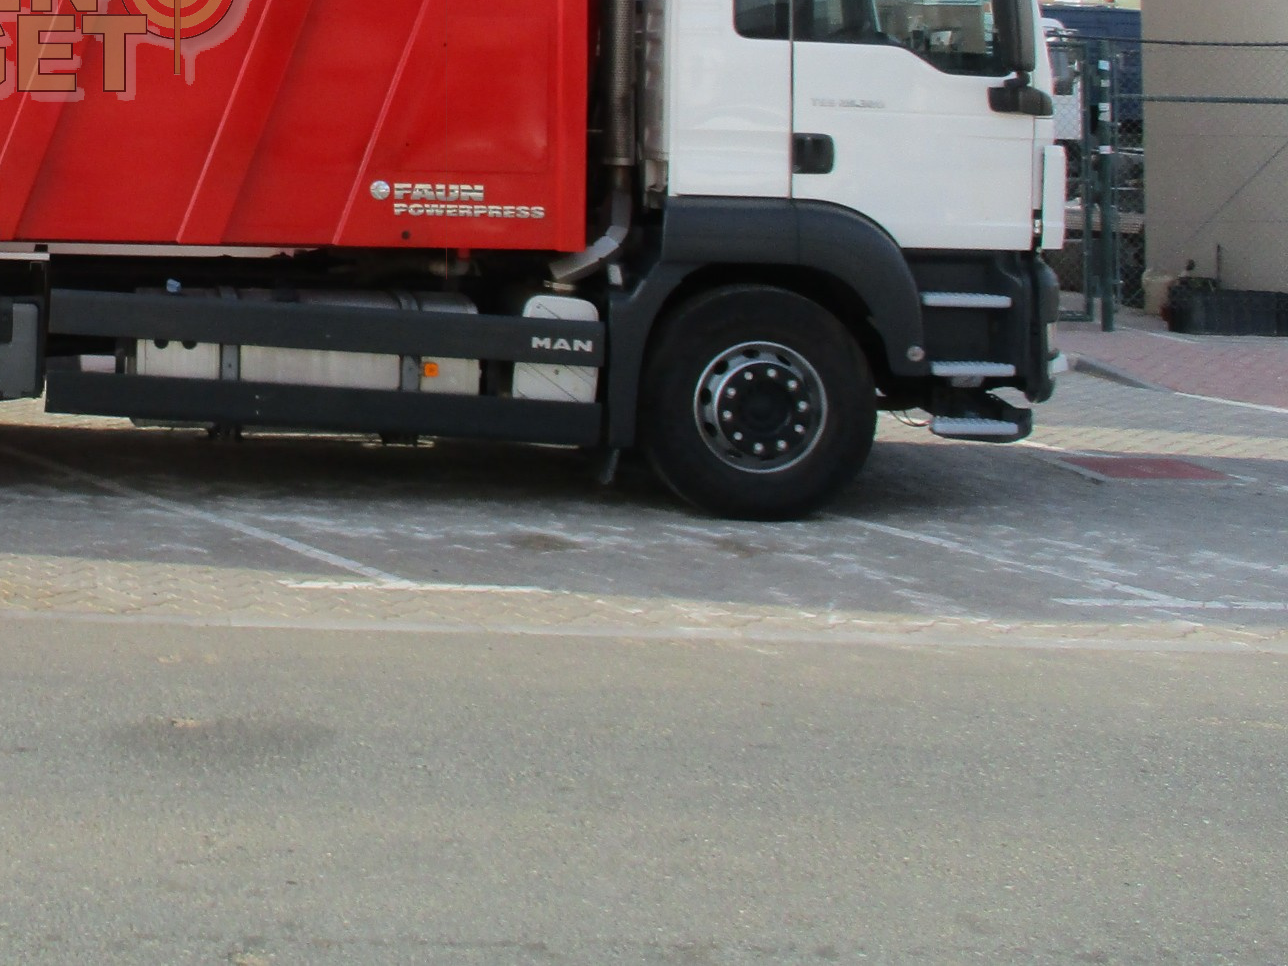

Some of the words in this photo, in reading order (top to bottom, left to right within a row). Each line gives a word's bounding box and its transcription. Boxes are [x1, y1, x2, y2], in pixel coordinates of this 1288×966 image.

[393, 182, 485, 202] FAUN
[393, 202, 546, 219] POWERPRESS
[531, 335, 594, 353] MAN
